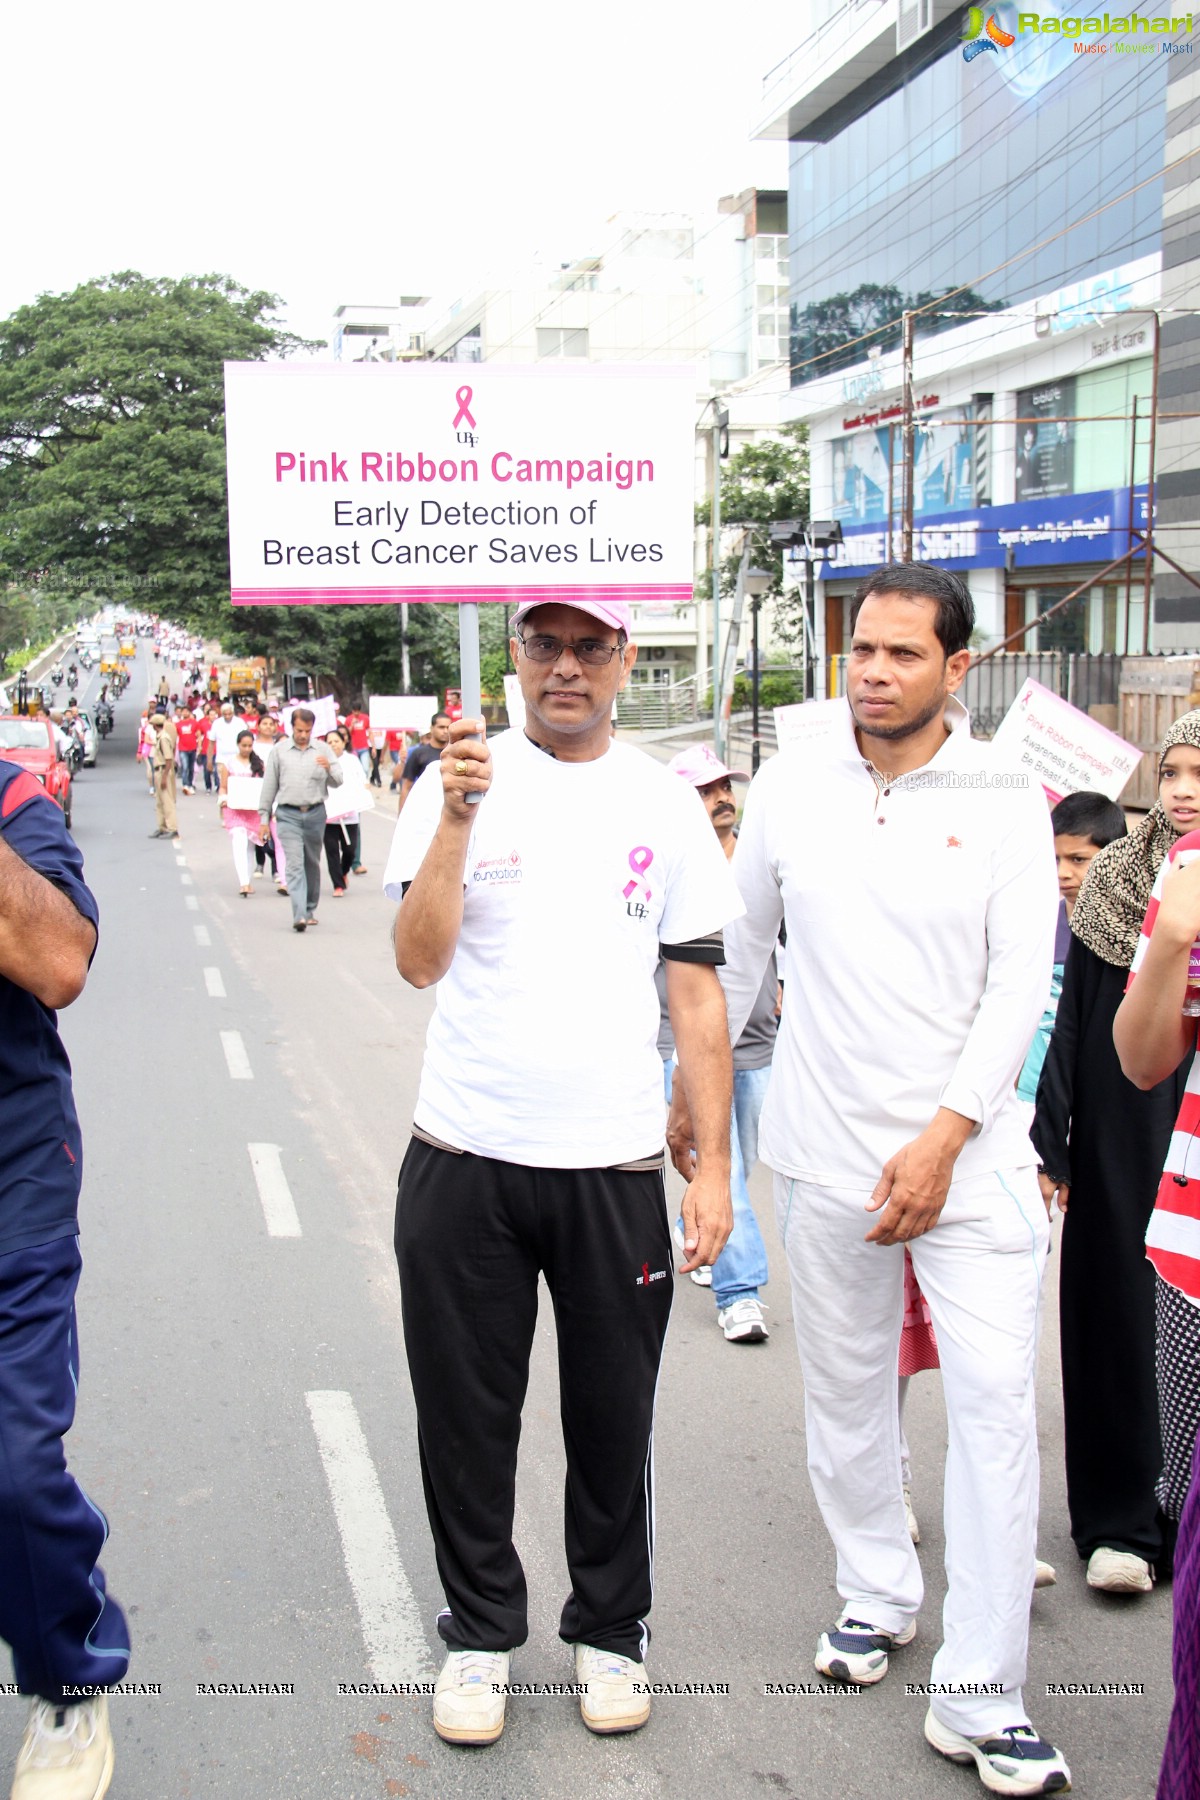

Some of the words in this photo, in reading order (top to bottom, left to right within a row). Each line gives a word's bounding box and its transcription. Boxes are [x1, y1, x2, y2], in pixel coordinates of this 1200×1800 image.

[1121, 330, 1145, 349] care
[456, 431, 480, 448] UBF
[275, 451, 348, 482] Pink
[361, 451, 479, 483] Ribbon
[491, 451, 655, 490] Campaign
[333, 500, 409, 532] Early
[420, 500, 558, 526] Detection
[569, 499, 598, 525] of
[263, 539, 360, 565] Breast
[370, 538, 478, 564] Cancer
[488, 537, 578, 563] Saves
[589, 536, 664, 562] Lives
[1022, 735, 1067, 769] Awareness
[1066, 762, 1079, 776] for
[1079, 769, 1091, 784] life
[1026, 713, 1045, 732] Pink
[1046, 726, 1074, 752] Ribbon
[1074, 745, 1113, 777] Campaign
[1021, 752, 1034, 766] Be
[1034, 760, 1061, 783] Breast
[474, 867, 523, 882] foundation
